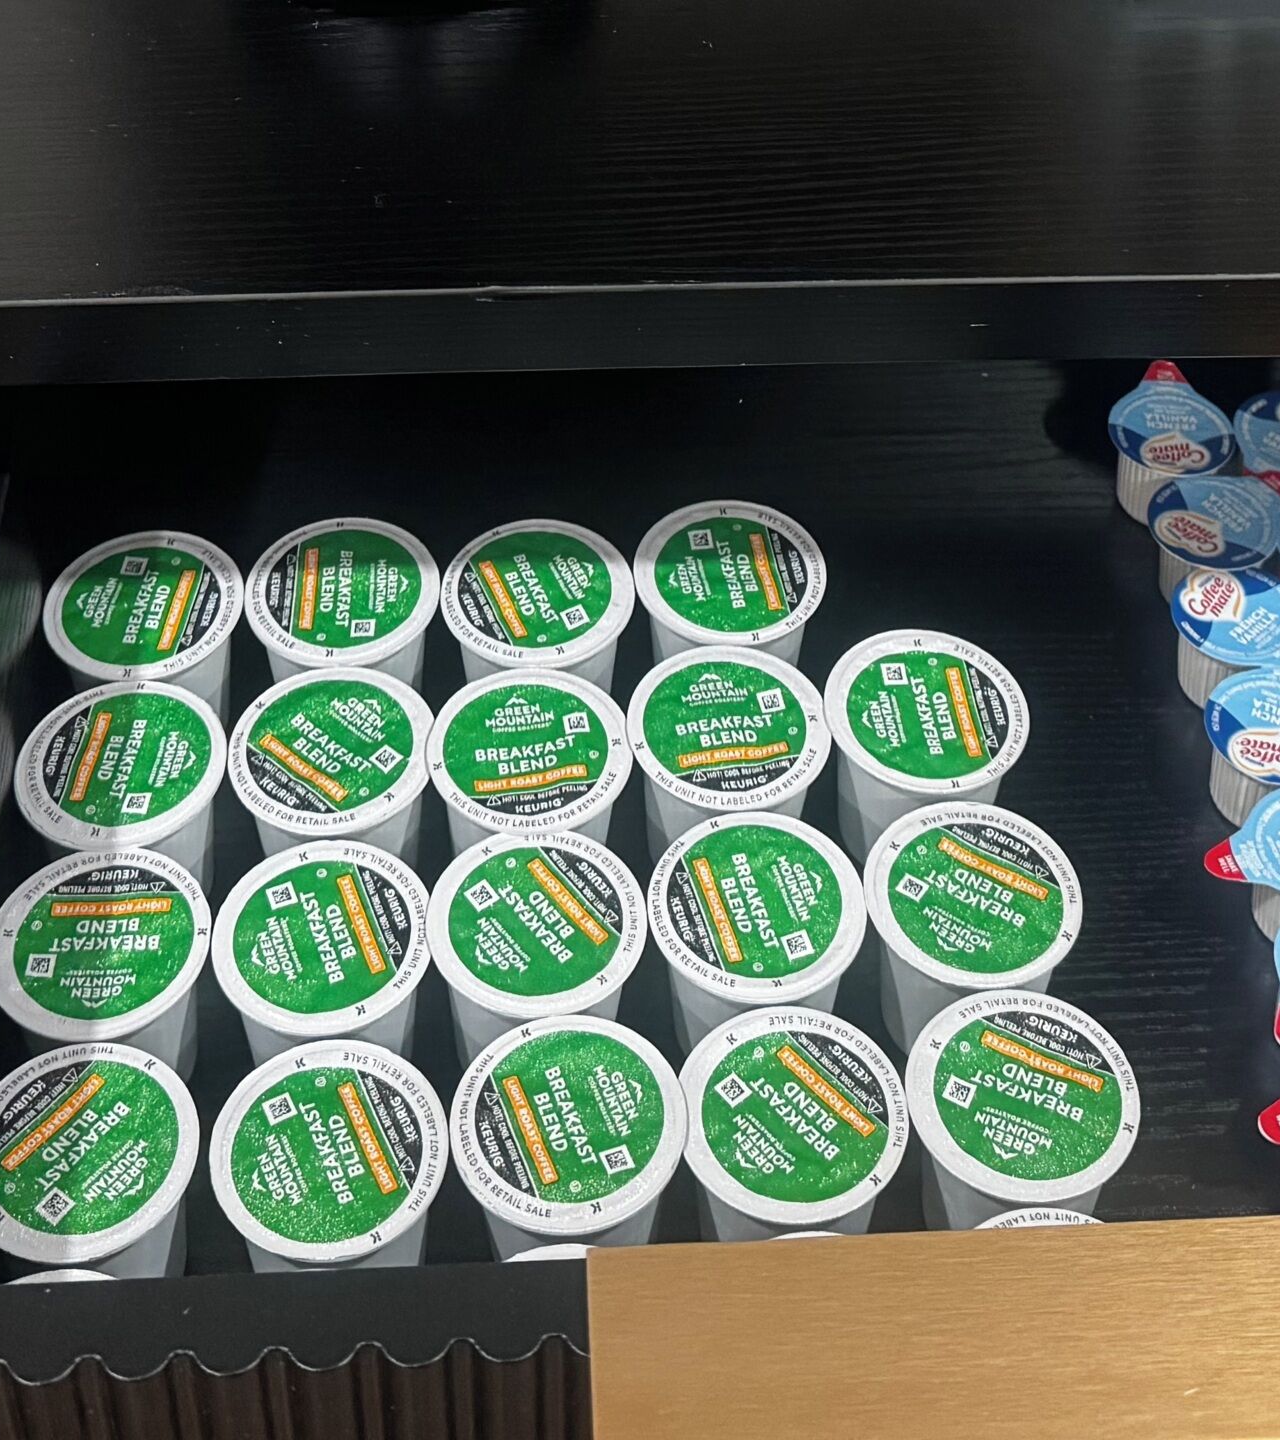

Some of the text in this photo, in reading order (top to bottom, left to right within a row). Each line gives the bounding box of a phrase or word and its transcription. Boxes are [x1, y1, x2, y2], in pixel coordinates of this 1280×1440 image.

[318, 562, 336, 608] BLEND
[334, 549, 353, 624] BREAKFAST
[501, 569, 536, 615] BLEND
[510, 552, 560, 623] BREAKFAST
[714, 539, 748, 612] BREAKFAST
[734, 552, 760, 597] BLEND
[1188, 577, 1224, 616] Coffee
[120, 566, 161, 642] BREAKFAST
[143, 584, 172, 629] BLEND
[1210, 582, 1236, 617] mate
[1229, 606, 1269, 638] FRENCH
[1236, 613, 1279, 645] VANILLA
[681, 688, 749, 703] MOUNTAIN
[689, 680, 734, 693] GREEN
[675, 714, 773, 736] BREAKFAST
[699, 730, 758, 747] BLEND
[908, 675, 945, 757] BREAKFAST
[930, 689, 958, 740] BLEND
[95, 730, 126, 781] BLEND
[108, 716, 149, 800] BREAKFAST
[288, 713, 373, 774] BREAKFAST
[289, 734, 343, 775] BLEND
[473, 735, 576, 765] BREAKFAST
[496, 753, 560, 776] BLEND
[682, 743, 787, 765] LIGHT ROAST COFFEE
[656, 748, 817, 805] THIS UNIT NOT LABELED FOR RETAIL SALE
[721, 775, 768, 790] KEURIG
[981, 826, 1031, 856] KEURIG
[575, 859, 615, 899] KEURIG
[717, 871, 754, 931] BLEND
[728, 850, 780, 945] BREAKFAST
[774, 854, 812, 922] MOUNTAIN
[789, 860, 820, 908] GREEN
[922, 868, 1027, 929] BREAKFAST
[952, 864, 1016, 906] BLEND
[75, 917, 142, 934] BLEND
[298, 890, 346, 983] BREAKFAST
[323, 901, 358, 960] BLEND
[495, 883, 574, 963] BREAKFAST
[525, 887, 576, 940] BLEND
[920, 905, 993, 950] MOUNTAIN
[925, 920, 977, 954] GREEN
[46, 933, 160, 952] BREAKFAST
[254, 929, 282, 977] GREEN
[264, 915, 298, 983] MOUNTAIN
[471, 930, 513, 972] GREEN
[475, 915, 530, 973] MOUNTAIN
[1025, 1014, 1079, 1043] KEURIG
[828, 1043, 875, 1086] KEURIG
[1000, 1059, 1070, 1100] BLEND
[387, 1094, 420, 1143] KEURIG
[541, 1063, 599, 1166] BREAKFAST
[591, 1064, 632, 1138] MOUNTAIN
[608, 1069, 641, 1122] GREEN
[747, 1074, 841, 1162] BREAKFAST
[779, 1076, 840, 1135] BLEND
[968, 1066, 1084, 1125] BREAKFAST
[35, 1099, 132, 1194] BREAKFAST
[38, 1104, 102, 1163] BLEND
[325, 1112, 367, 1179] BLEND
[476, 1122, 508, 1171] KEURIG
[530, 1089, 571, 1155] BLEND
[730, 1112, 796, 1176] MOUNTAIN
[972, 1108, 1053, 1152] MOUNTAIN
[979, 1124, 1036, 1158] GREEN
[253, 1148, 286, 1203] GREEN
[263, 1131, 303, 1208] MOUNTAIN
[297, 1101, 356, 1207] BREAKFAST
[729, 1129, 777, 1176] GREEN
